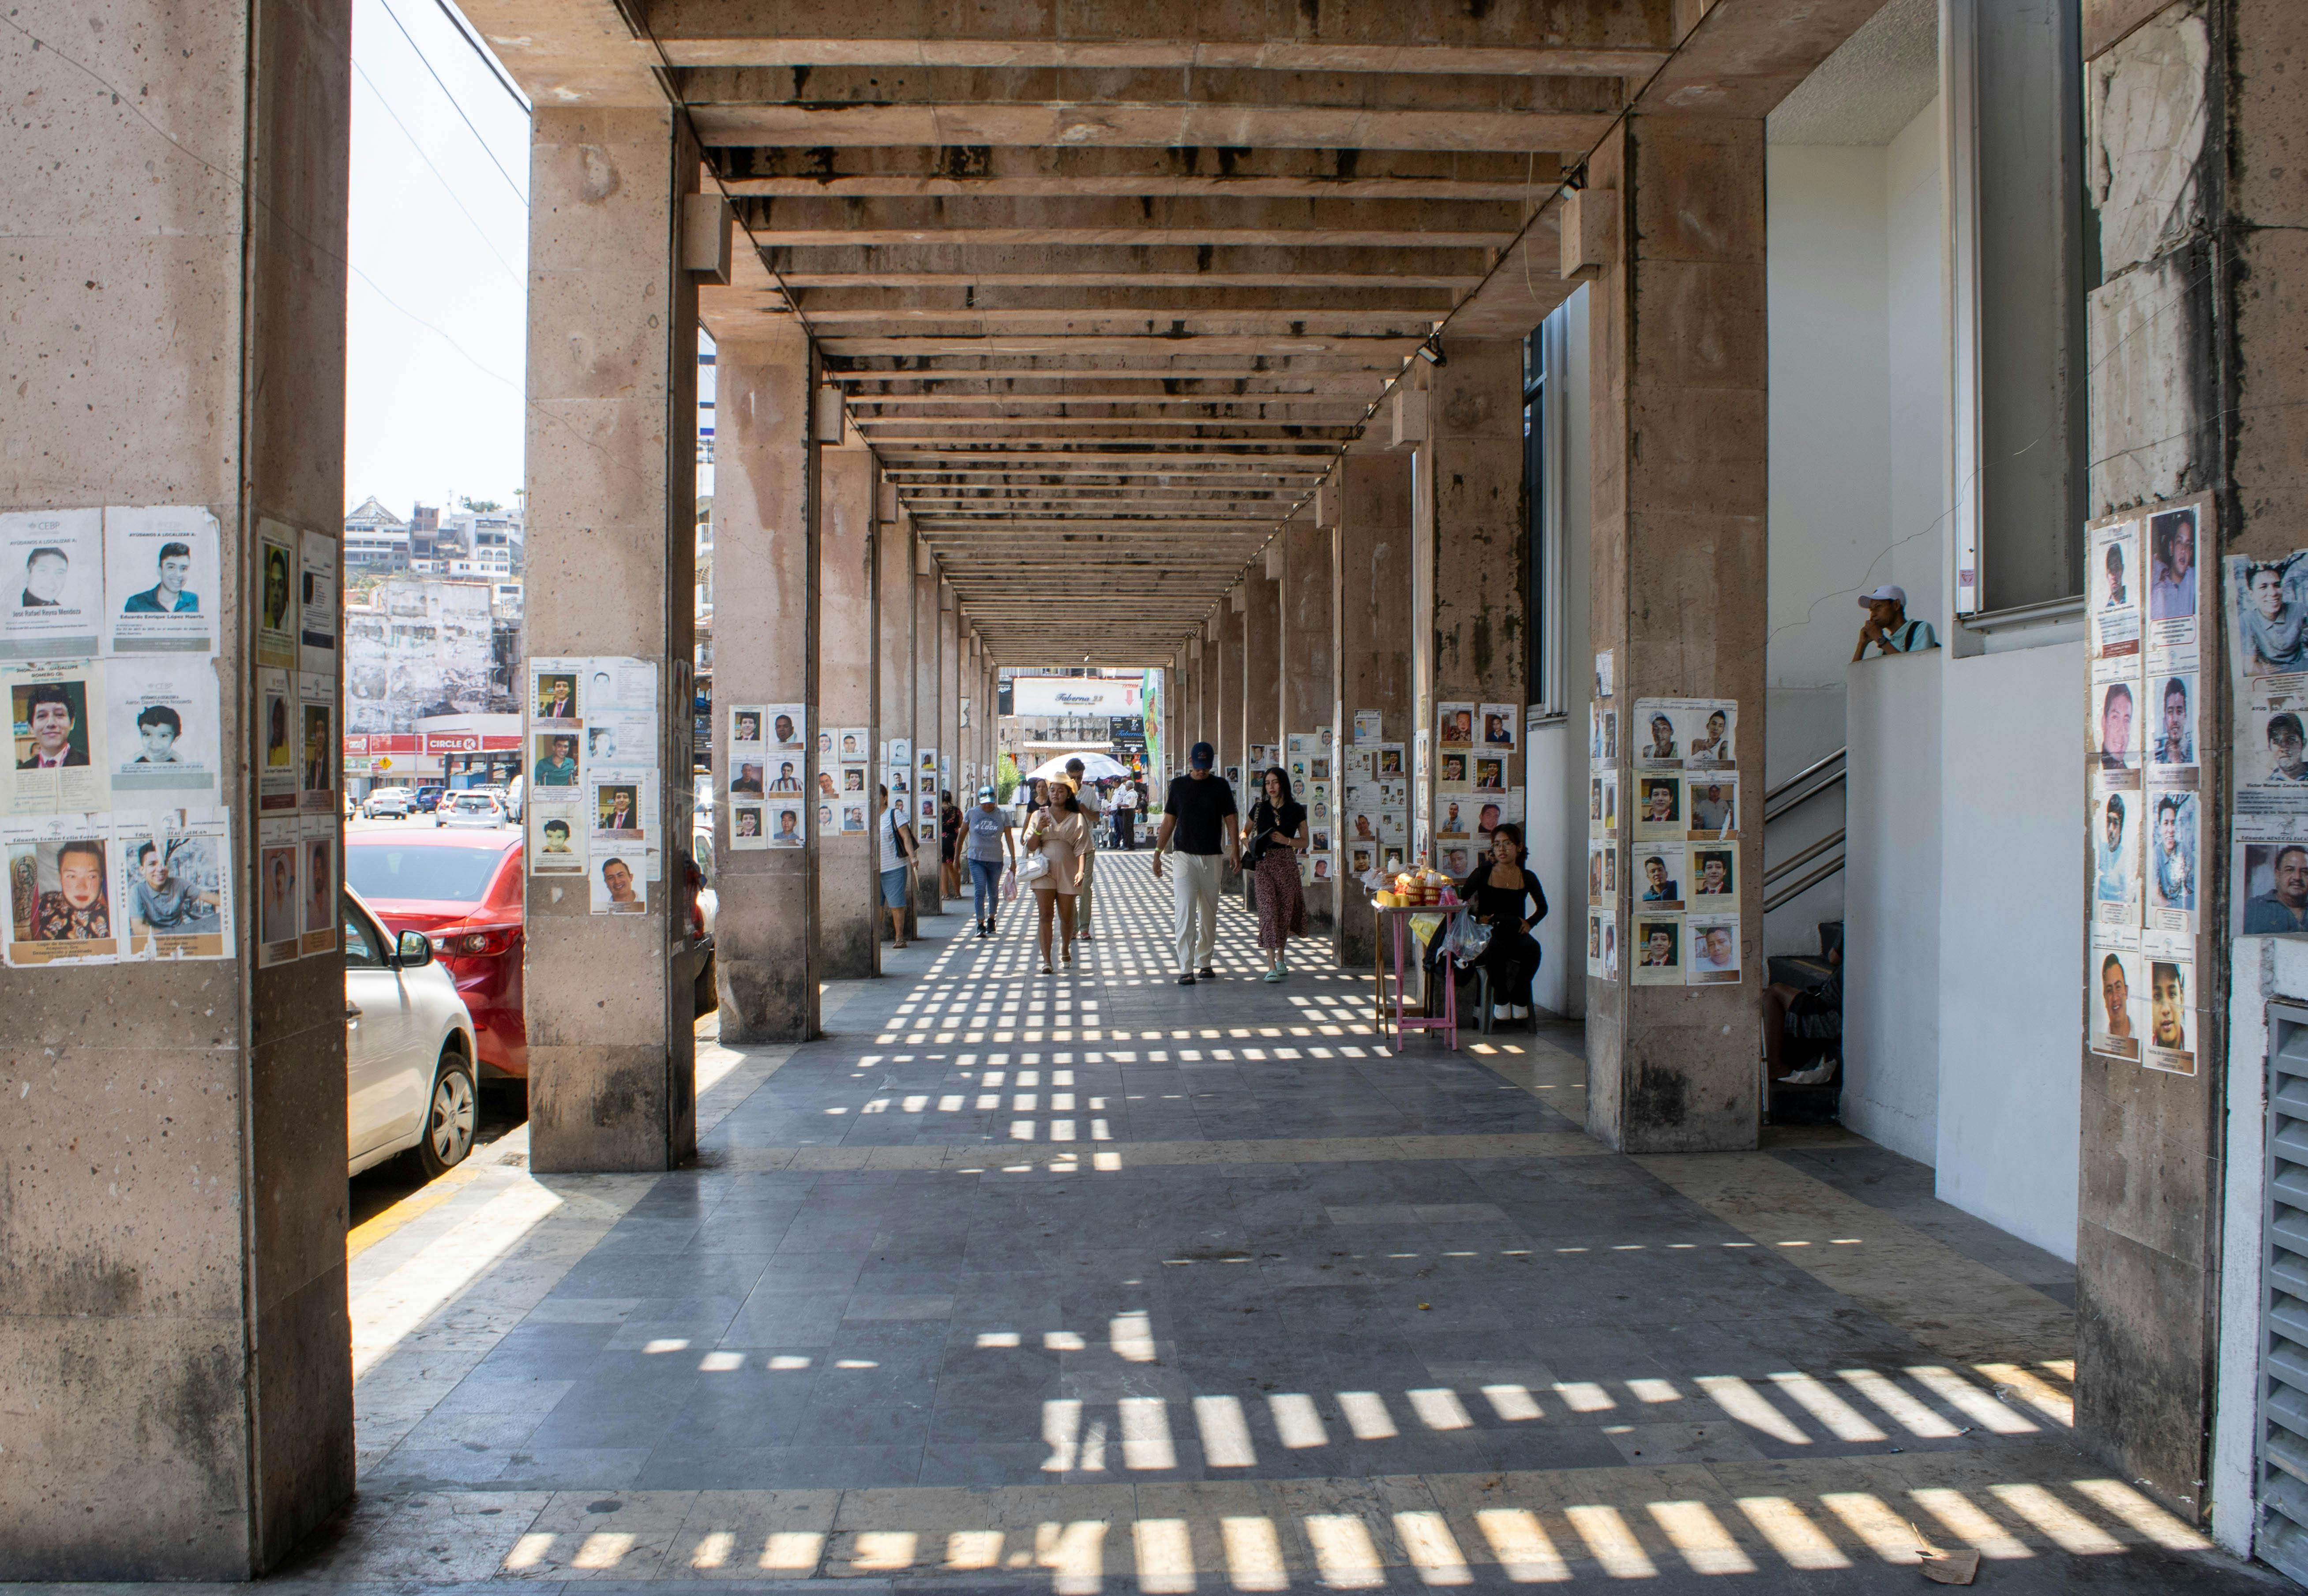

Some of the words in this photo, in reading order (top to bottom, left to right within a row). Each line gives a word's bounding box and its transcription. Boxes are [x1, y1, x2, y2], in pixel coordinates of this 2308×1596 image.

[38, 521, 60, 530] CEBP
[1055, 693, 1090, 701] Taberna
[429, 740, 462, 748] CIRCLE
